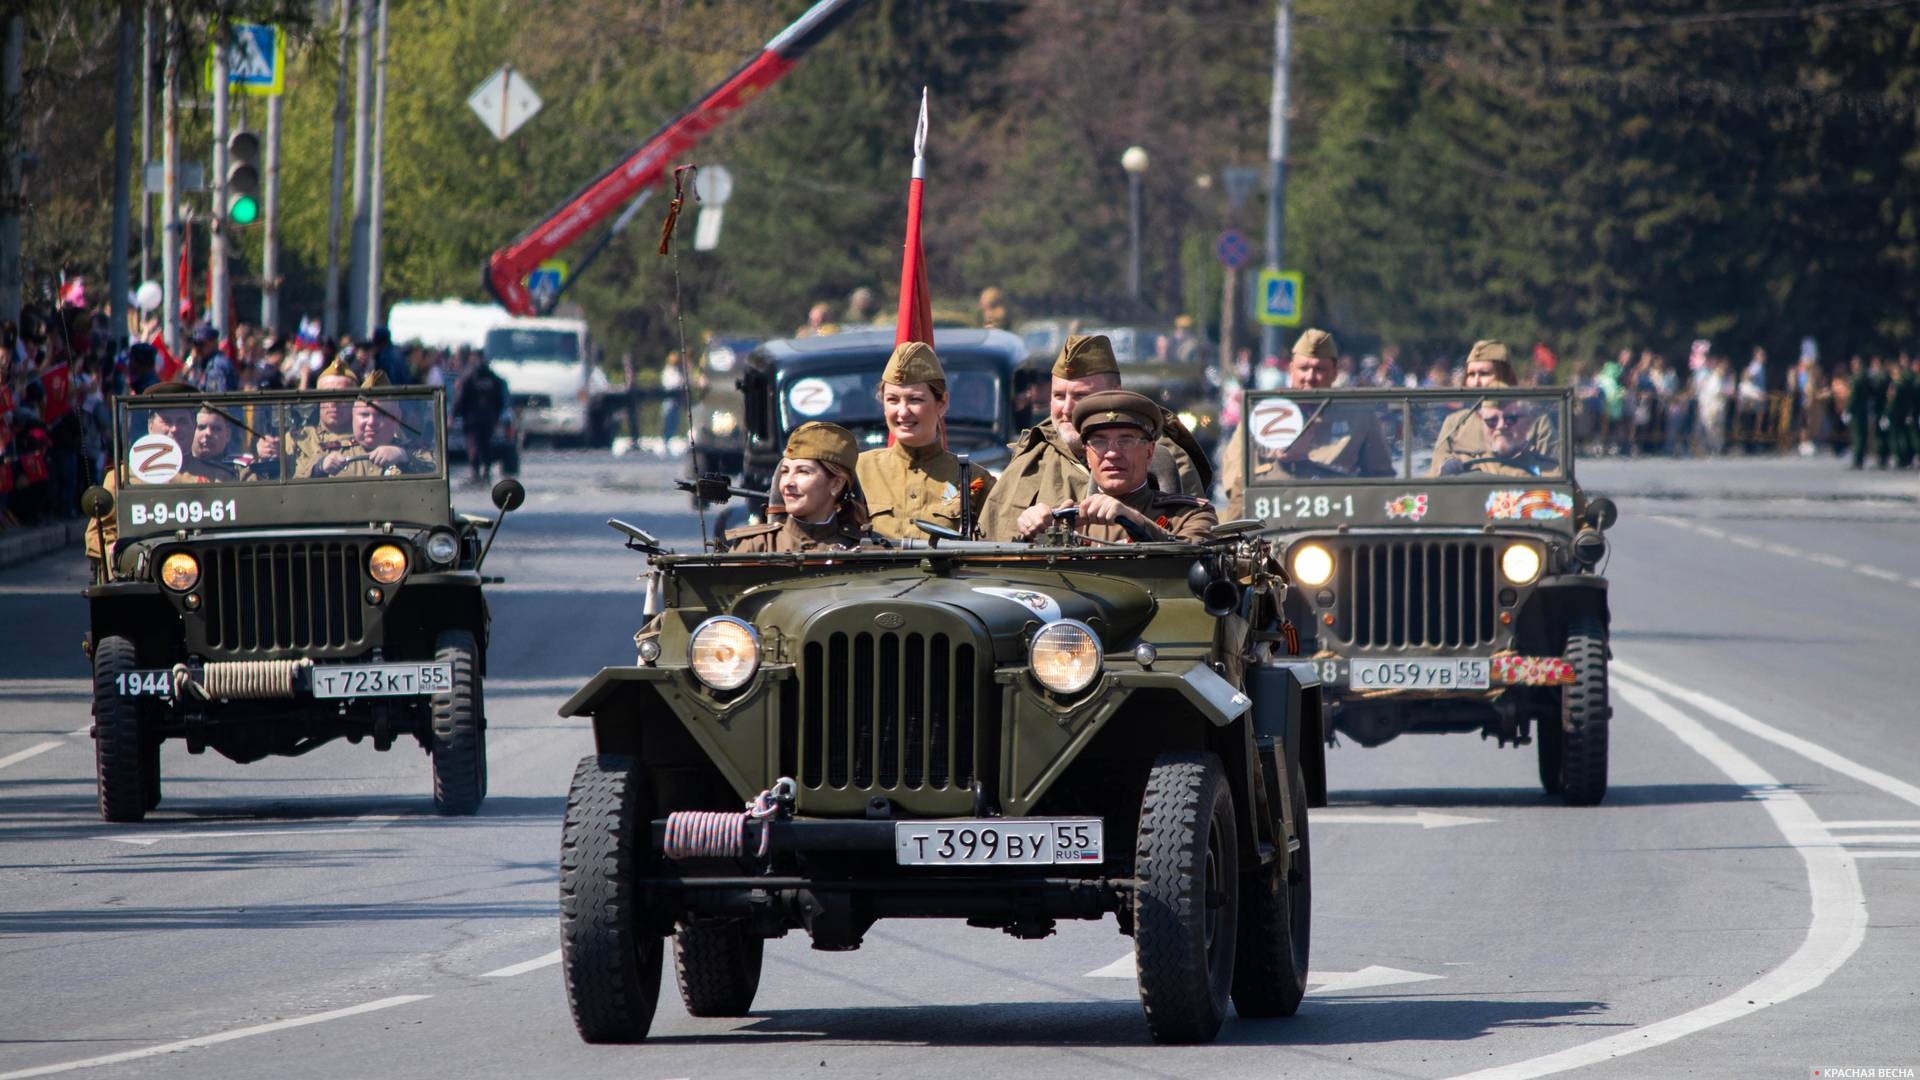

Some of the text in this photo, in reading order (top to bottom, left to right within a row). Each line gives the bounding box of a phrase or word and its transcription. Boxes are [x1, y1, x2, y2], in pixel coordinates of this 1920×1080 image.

[1254, 407, 1297, 436] Z
[133, 443, 178, 473] Z
[1255, 494, 1354, 519] 81-28-1
[421, 667, 443, 684] 55
[1459, 661, 1482, 679] 55
[115, 671, 171, 696] 1944
[1057, 825, 1090, 849] 55
[1056, 850, 1080, 859] RUS
